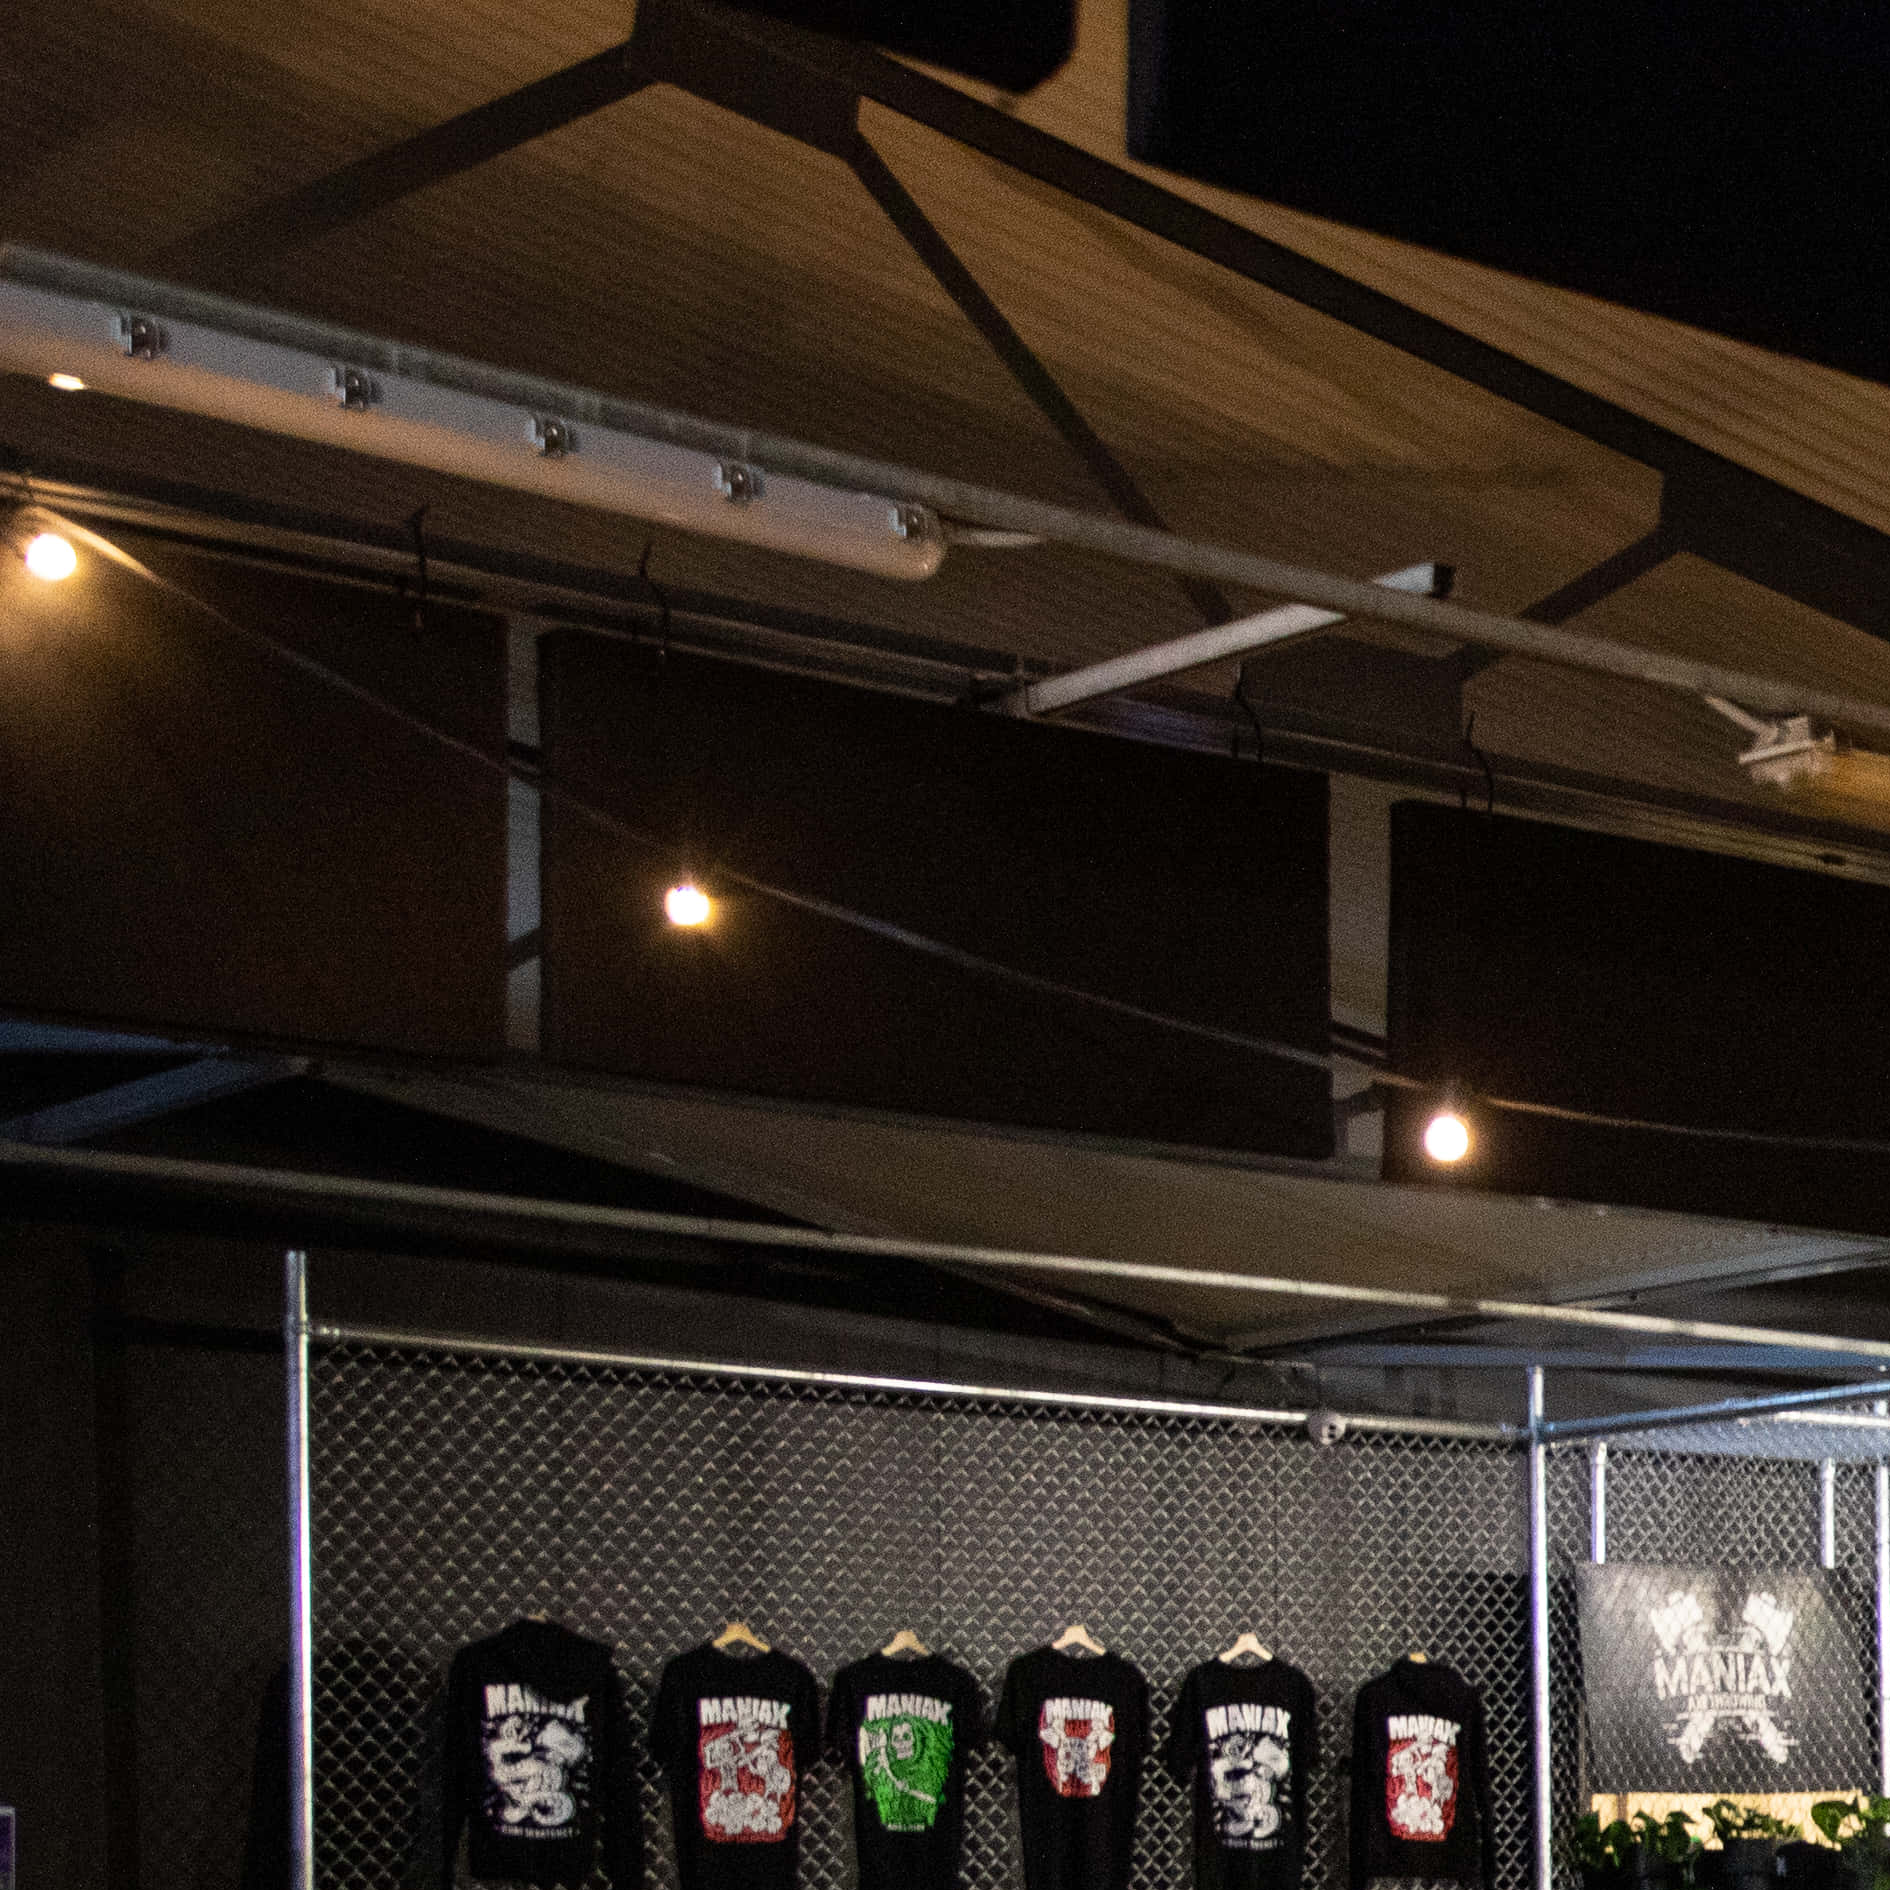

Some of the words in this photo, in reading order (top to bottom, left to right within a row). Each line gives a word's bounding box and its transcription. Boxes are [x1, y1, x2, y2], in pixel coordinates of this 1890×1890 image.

[1654, 1652, 1792, 1700] MANIAX
[700, 1697, 790, 1728] MANIAX
[867, 1694, 951, 1725] MANIAX
[1206, 1704, 1291, 1739] MANIAX
[1388, 1715, 1461, 1746] MANIAX
